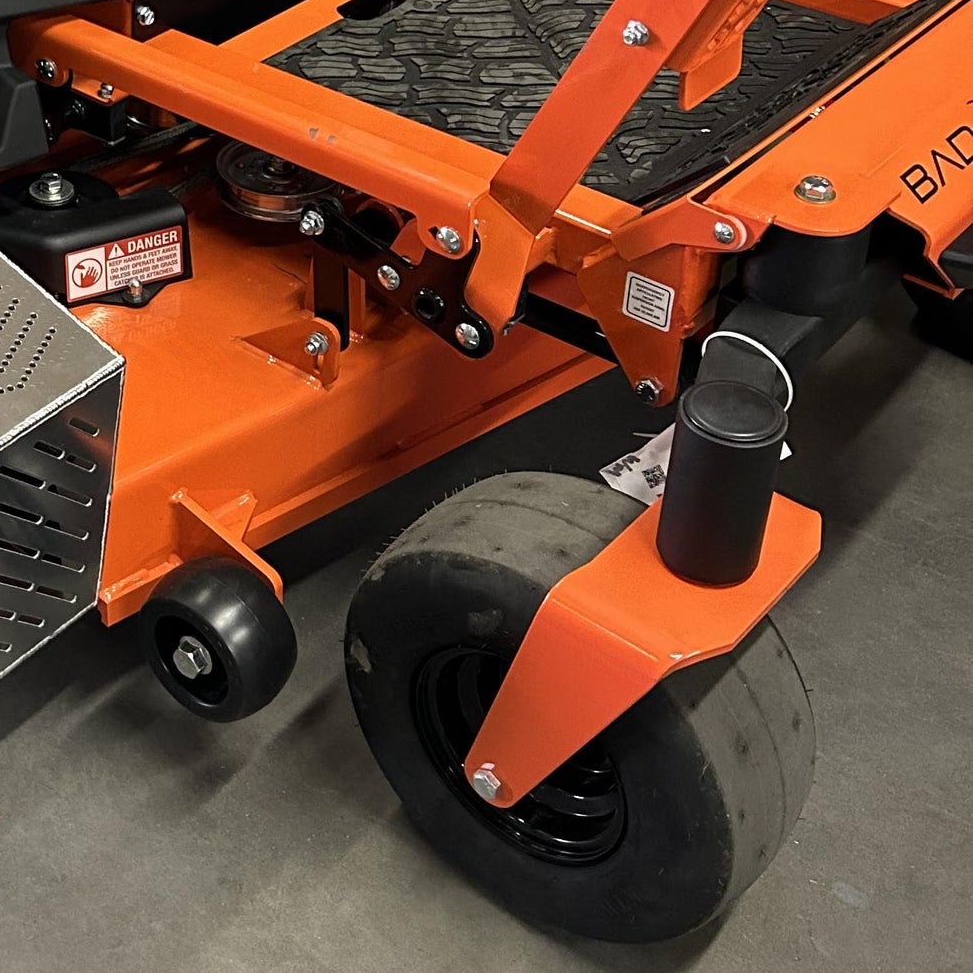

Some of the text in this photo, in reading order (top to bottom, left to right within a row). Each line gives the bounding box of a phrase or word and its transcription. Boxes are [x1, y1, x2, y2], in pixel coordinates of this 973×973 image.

[899, 125, 973, 205] BAD
[127, 230, 178, 254] DANGER
[108, 259, 123, 268] KEEP
[123, 254, 143, 264] HANDS
[148, 249, 161, 258] FEET
[109, 271, 131, 281] UNLESS
[131, 266, 150, 276] GUARD
[160, 258, 178, 268] GRASS
[110, 252, 177, 275] DO NOT OPERATE MOWER
